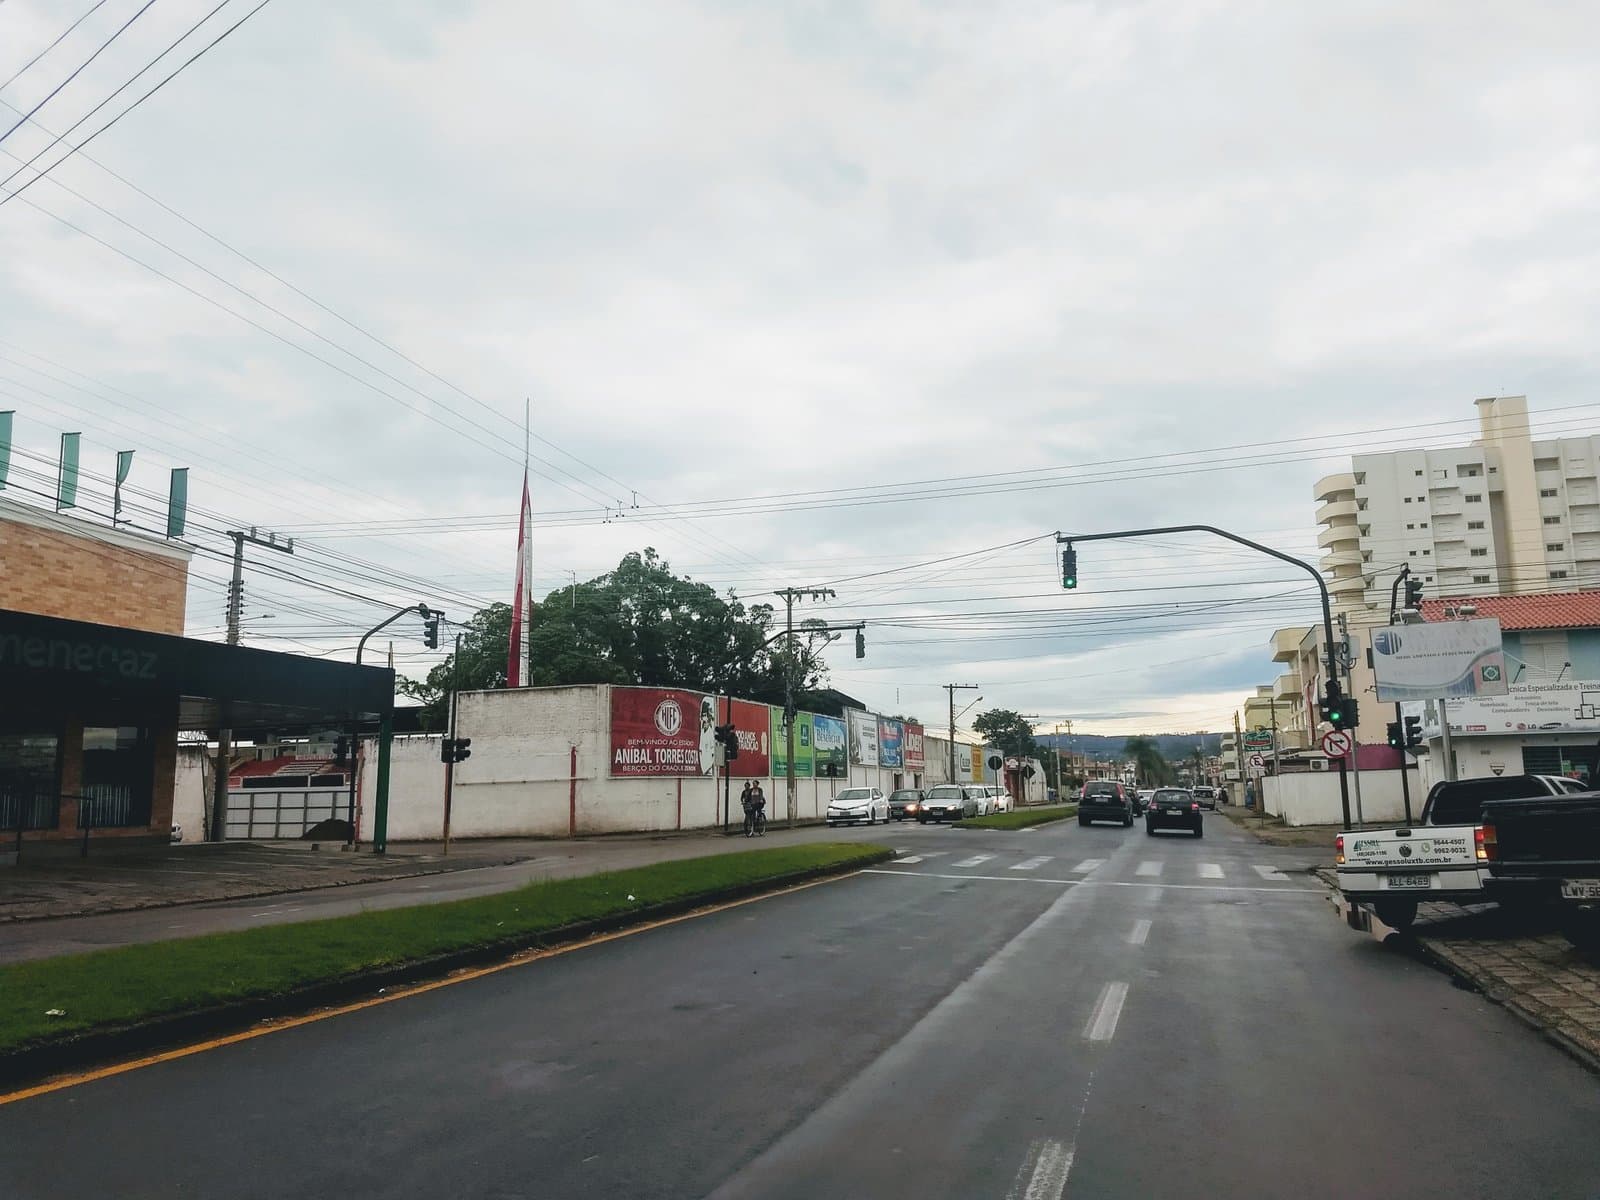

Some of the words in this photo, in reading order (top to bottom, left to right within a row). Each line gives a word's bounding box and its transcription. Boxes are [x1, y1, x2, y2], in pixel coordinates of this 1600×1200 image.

[1527, 683, 1572, 693] Especializada
[615, 746, 653, 764] ANÍBAL
[654, 748, 684, 764] TORRES
[622, 765, 647, 773] BERÇO
[1365, 857, 1452, 867] www.gessoluxtb.com.br
